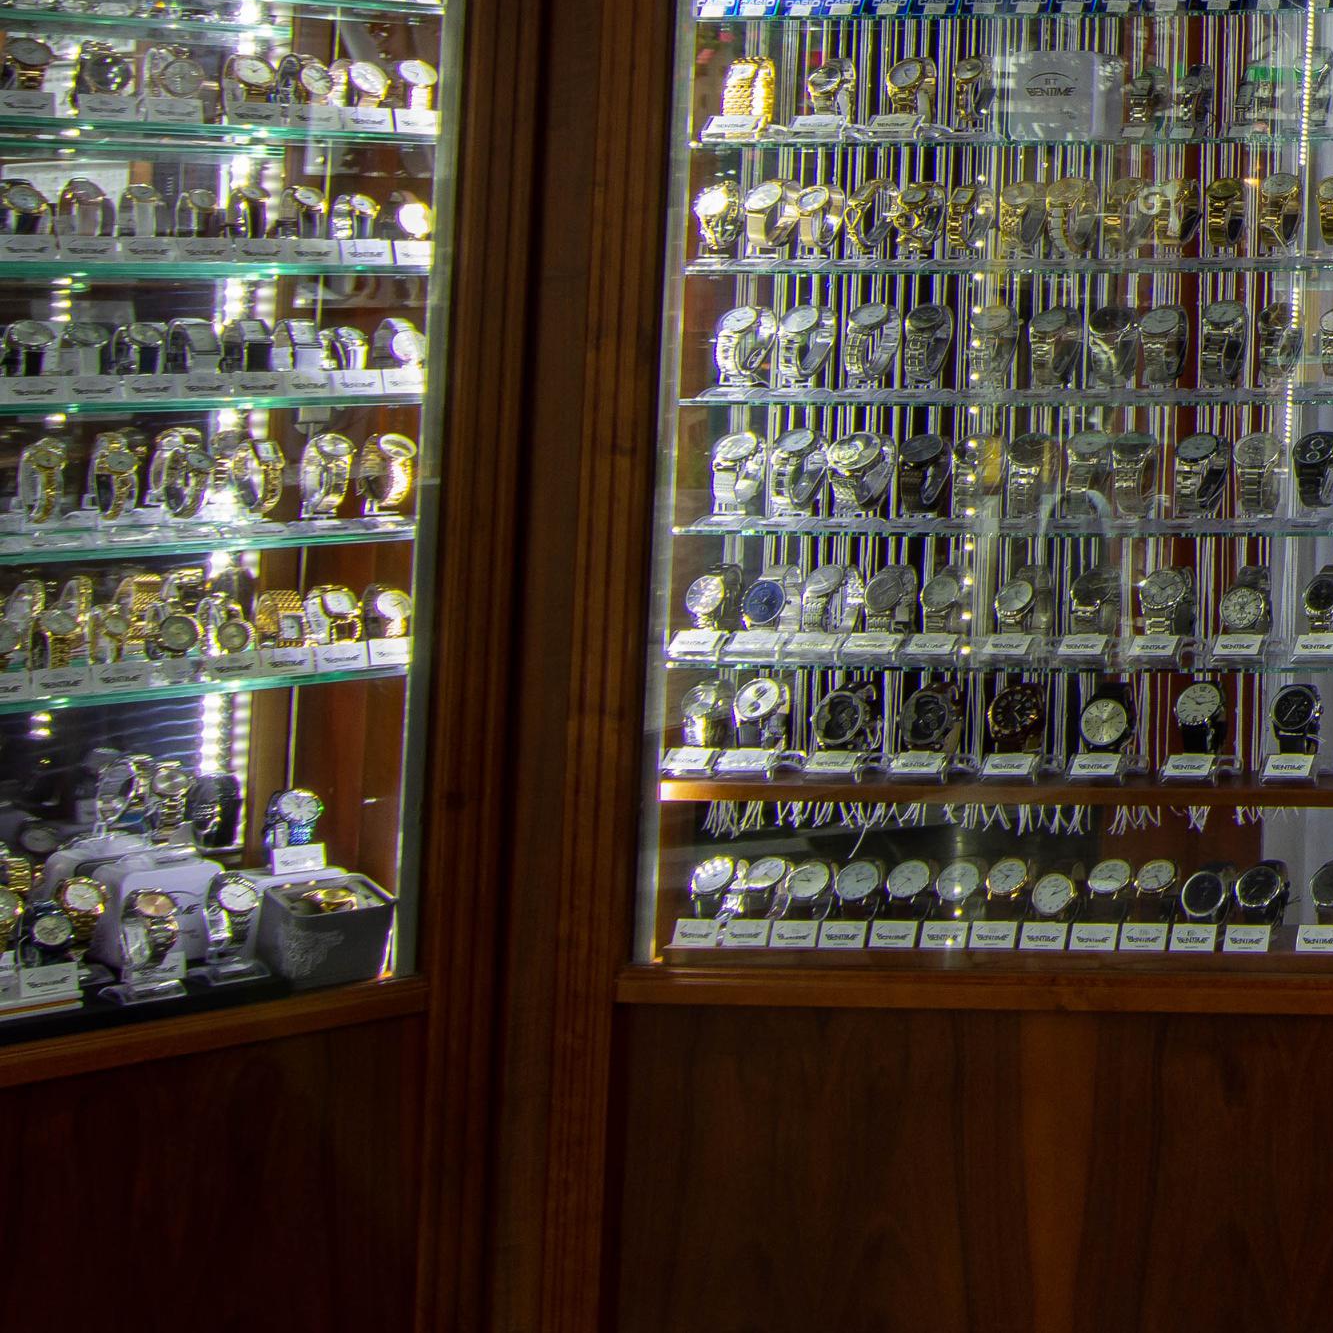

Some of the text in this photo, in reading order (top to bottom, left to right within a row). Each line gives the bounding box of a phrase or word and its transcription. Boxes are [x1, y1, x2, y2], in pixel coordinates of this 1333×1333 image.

[825, 0, 861, 8] CASIO
[918, 0, 955, 8] CASIO
[1221, 643, 1255, 651] BENTIME
[1272, 763, 1305, 771] BENTIME
[1230, 937, 1263, 946] BENTIME
